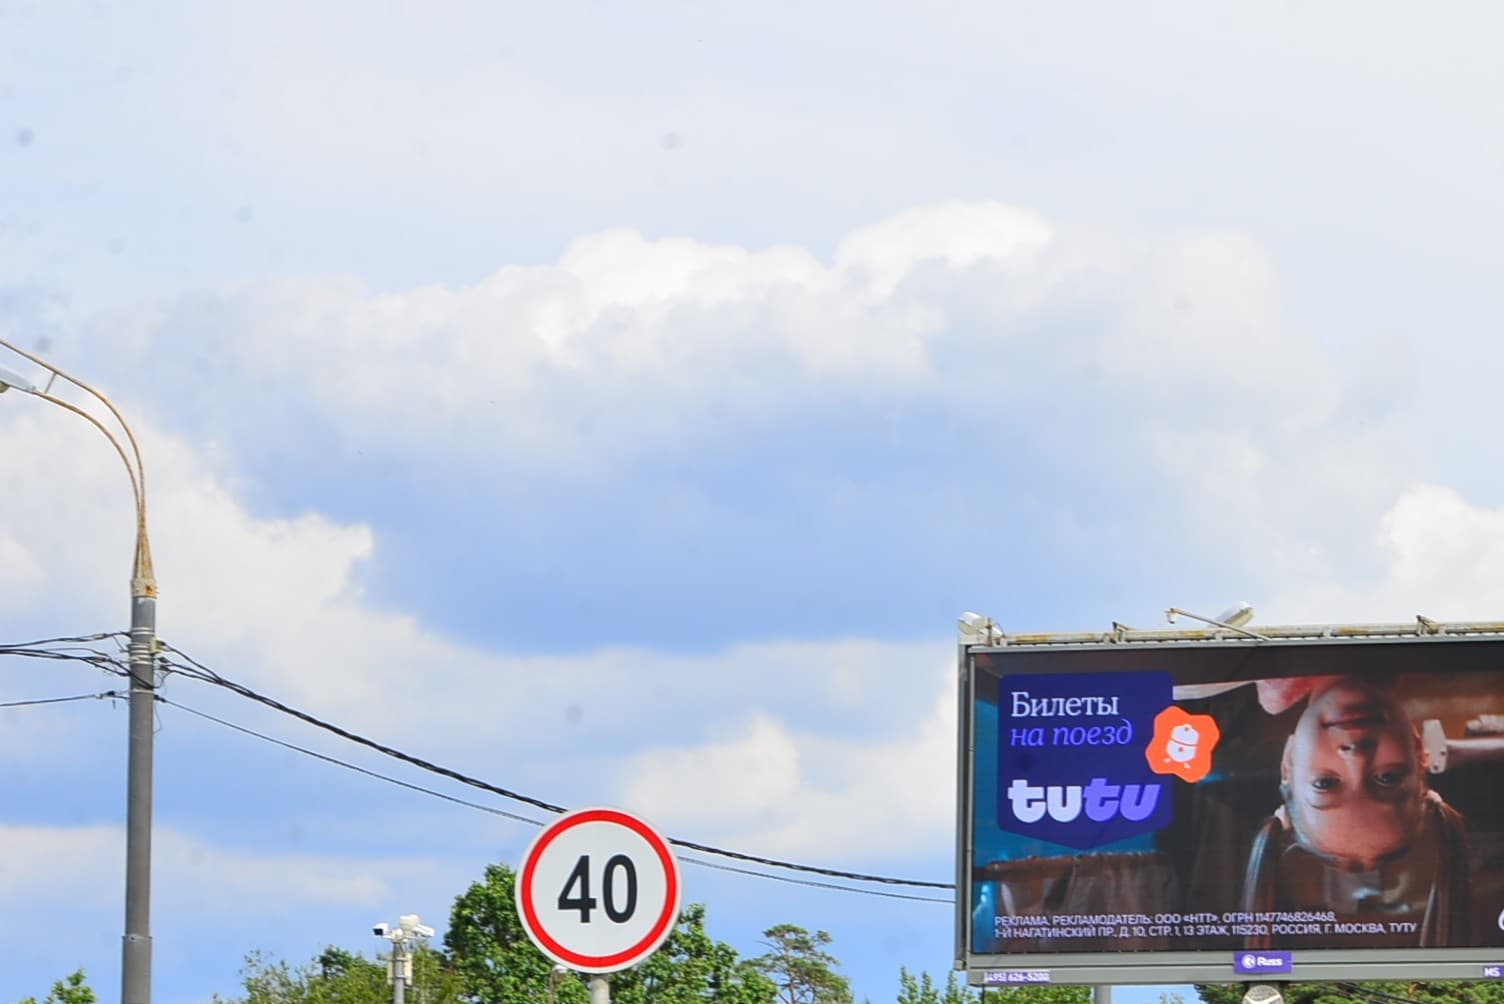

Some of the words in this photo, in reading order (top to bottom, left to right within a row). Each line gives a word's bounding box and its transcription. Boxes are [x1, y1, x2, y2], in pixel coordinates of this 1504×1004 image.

[1010, 691, 1120, 718] Билеты
[1010, 727, 1045, 747] на
[1052, 719, 1135, 746] поезд
[1007, 777, 1161, 823] tutu
[557, 853, 638, 924] 40
[993, 915, 1051, 926] РЕКЛАМА.
[1052, 914, 1154, 926] РЕКЛАМОДАТЕЛЬ:
[1155, 913, 1181, 924] ООО
[1222, 912, 1253, 923] ОГРН
[994, 926, 1012, 938] 1-Й
[1013, 925, 1096, 938] НАГАТИНСКИЙ
[1148, 925, 1173, 937] СТР.
[1183, 925, 1195, 936] 13
[1388, 922, 1417, 933] ТУТУ
[1256, 955, 1284, 967] Russ
